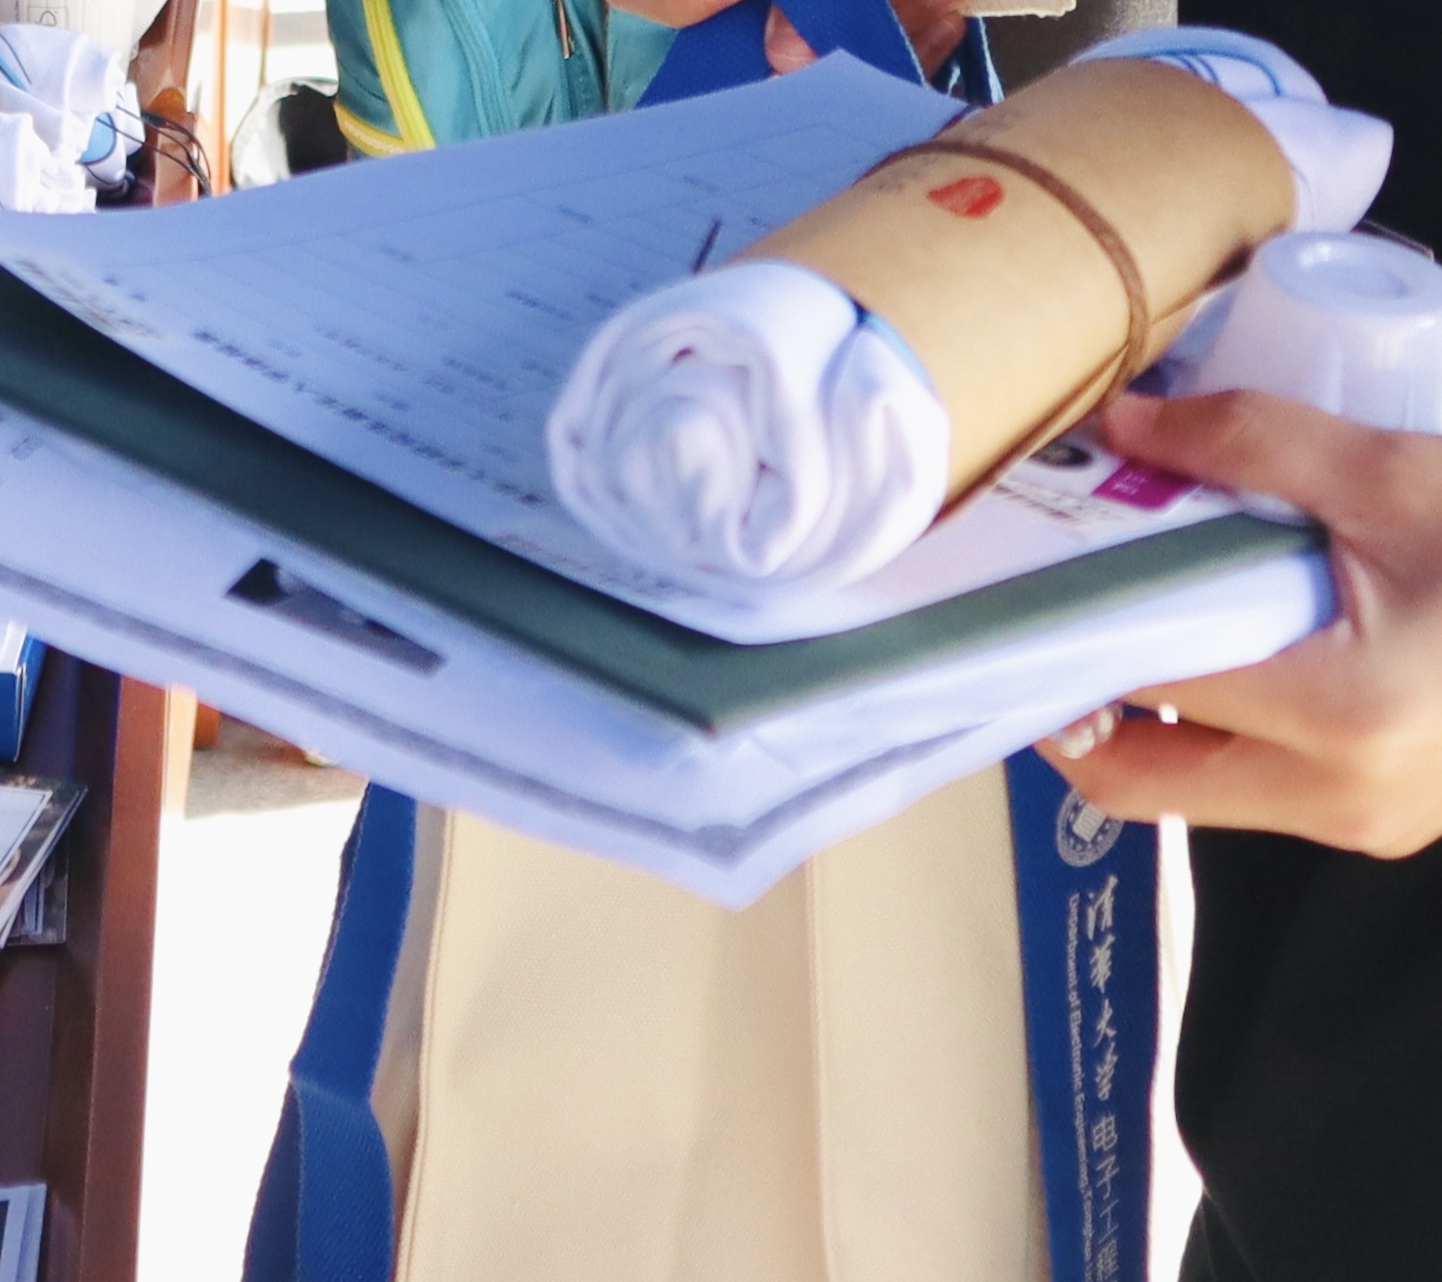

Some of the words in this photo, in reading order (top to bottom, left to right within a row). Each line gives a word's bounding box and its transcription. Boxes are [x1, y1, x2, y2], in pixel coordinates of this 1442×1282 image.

[1067, 893, 1081, 989] Department
[1068, 992, 1081, 1010] of
[1070, 1011, 1086, 1090] Electronic
[1085, 875, 1121, 1282] 清华大学电子工程
